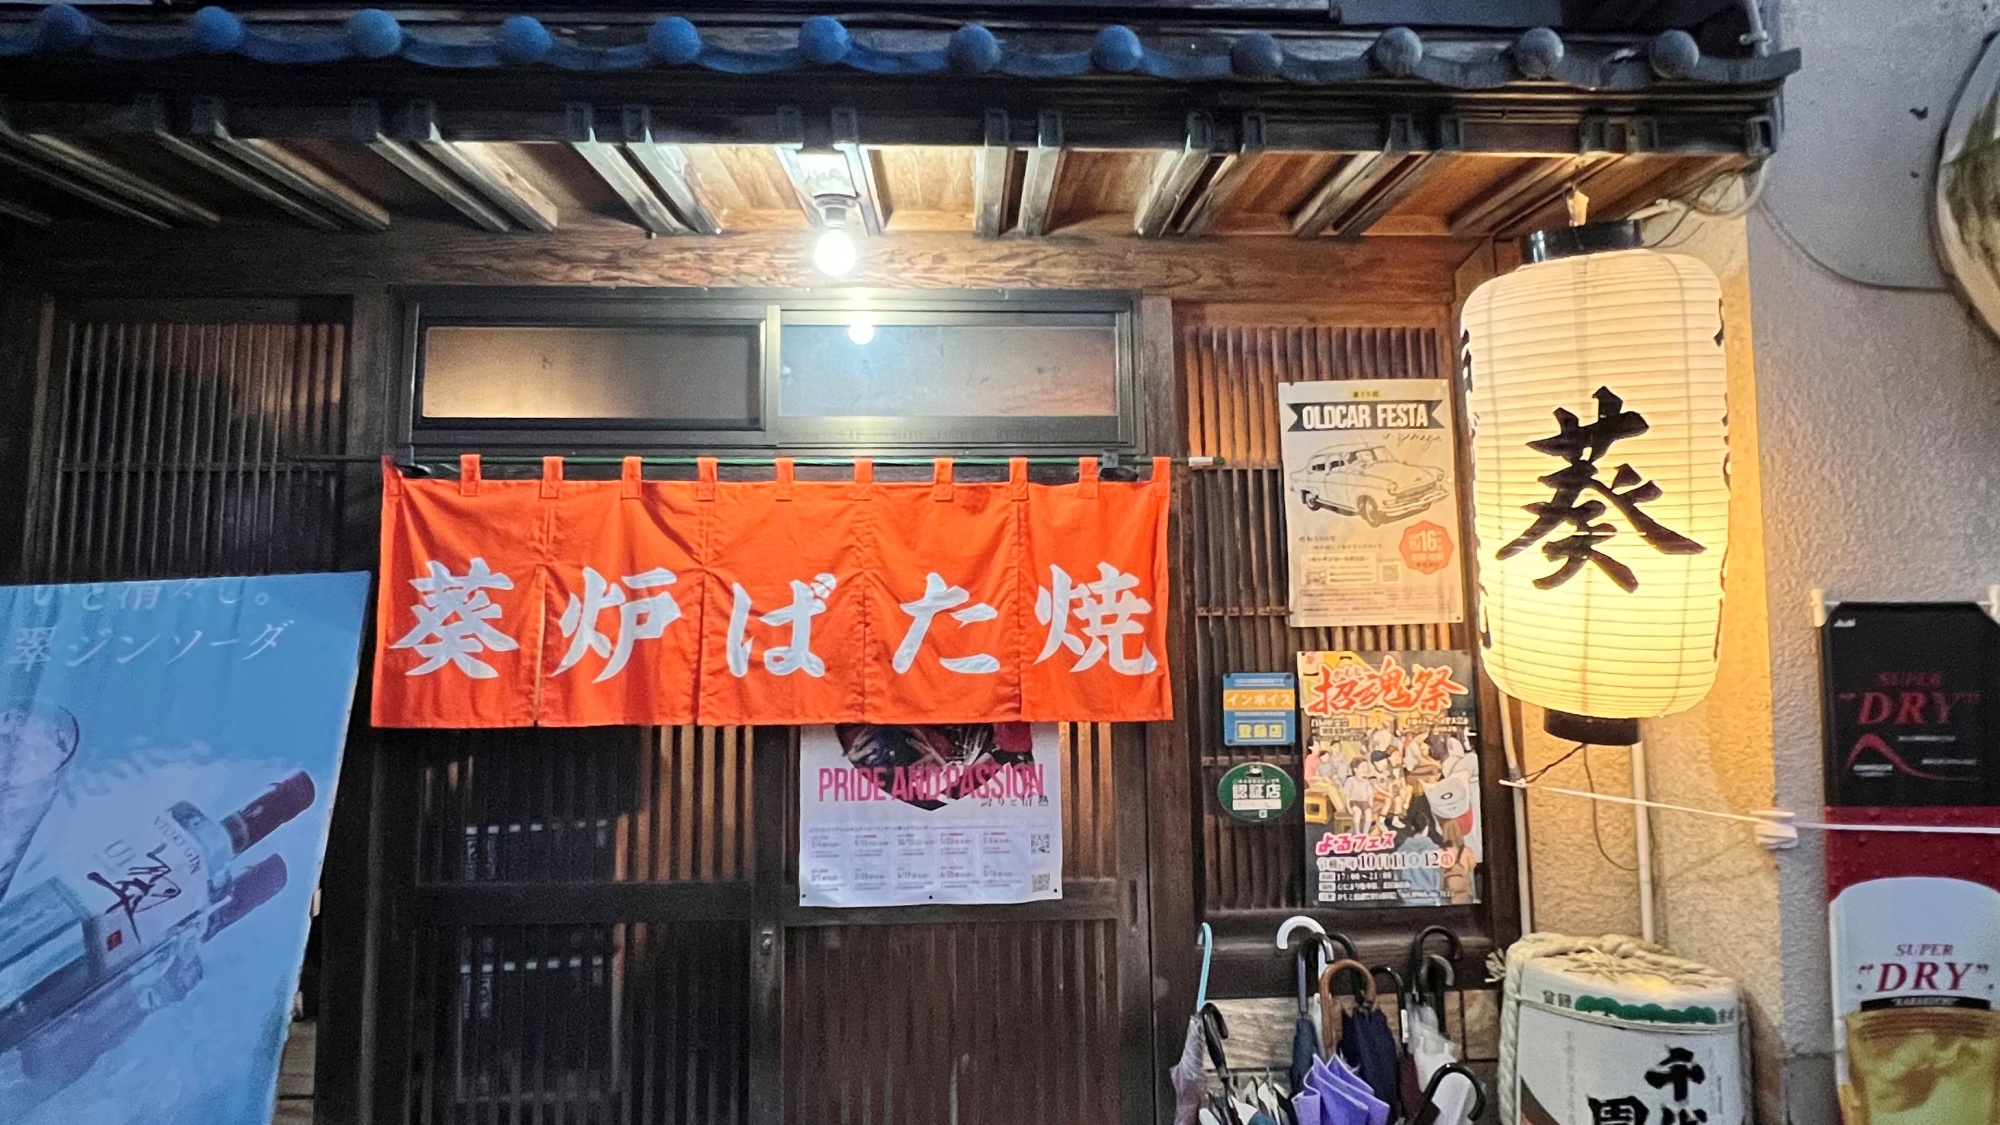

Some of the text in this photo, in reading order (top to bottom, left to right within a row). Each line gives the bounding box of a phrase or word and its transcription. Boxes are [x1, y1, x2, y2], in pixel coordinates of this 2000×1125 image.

[1302, 403, 1429, 430] OLDCAR FESTA
[1496, 385, 1708, 594] 葵
[389, 557, 1158, 684] 葵炉ばた焼
[7, 619, 294, 672] 翠ジンソーダ
[1228, 693, 1293, 709] インボイス
[1306, 657, 1470, 715] 招魂祭
[818, 767, 887, 802] PRIDE
[891, 764, 942, 800] AND
[945, 763, 1045, 801] PASSION
[1896, 943, 1955, 957] SUPER
